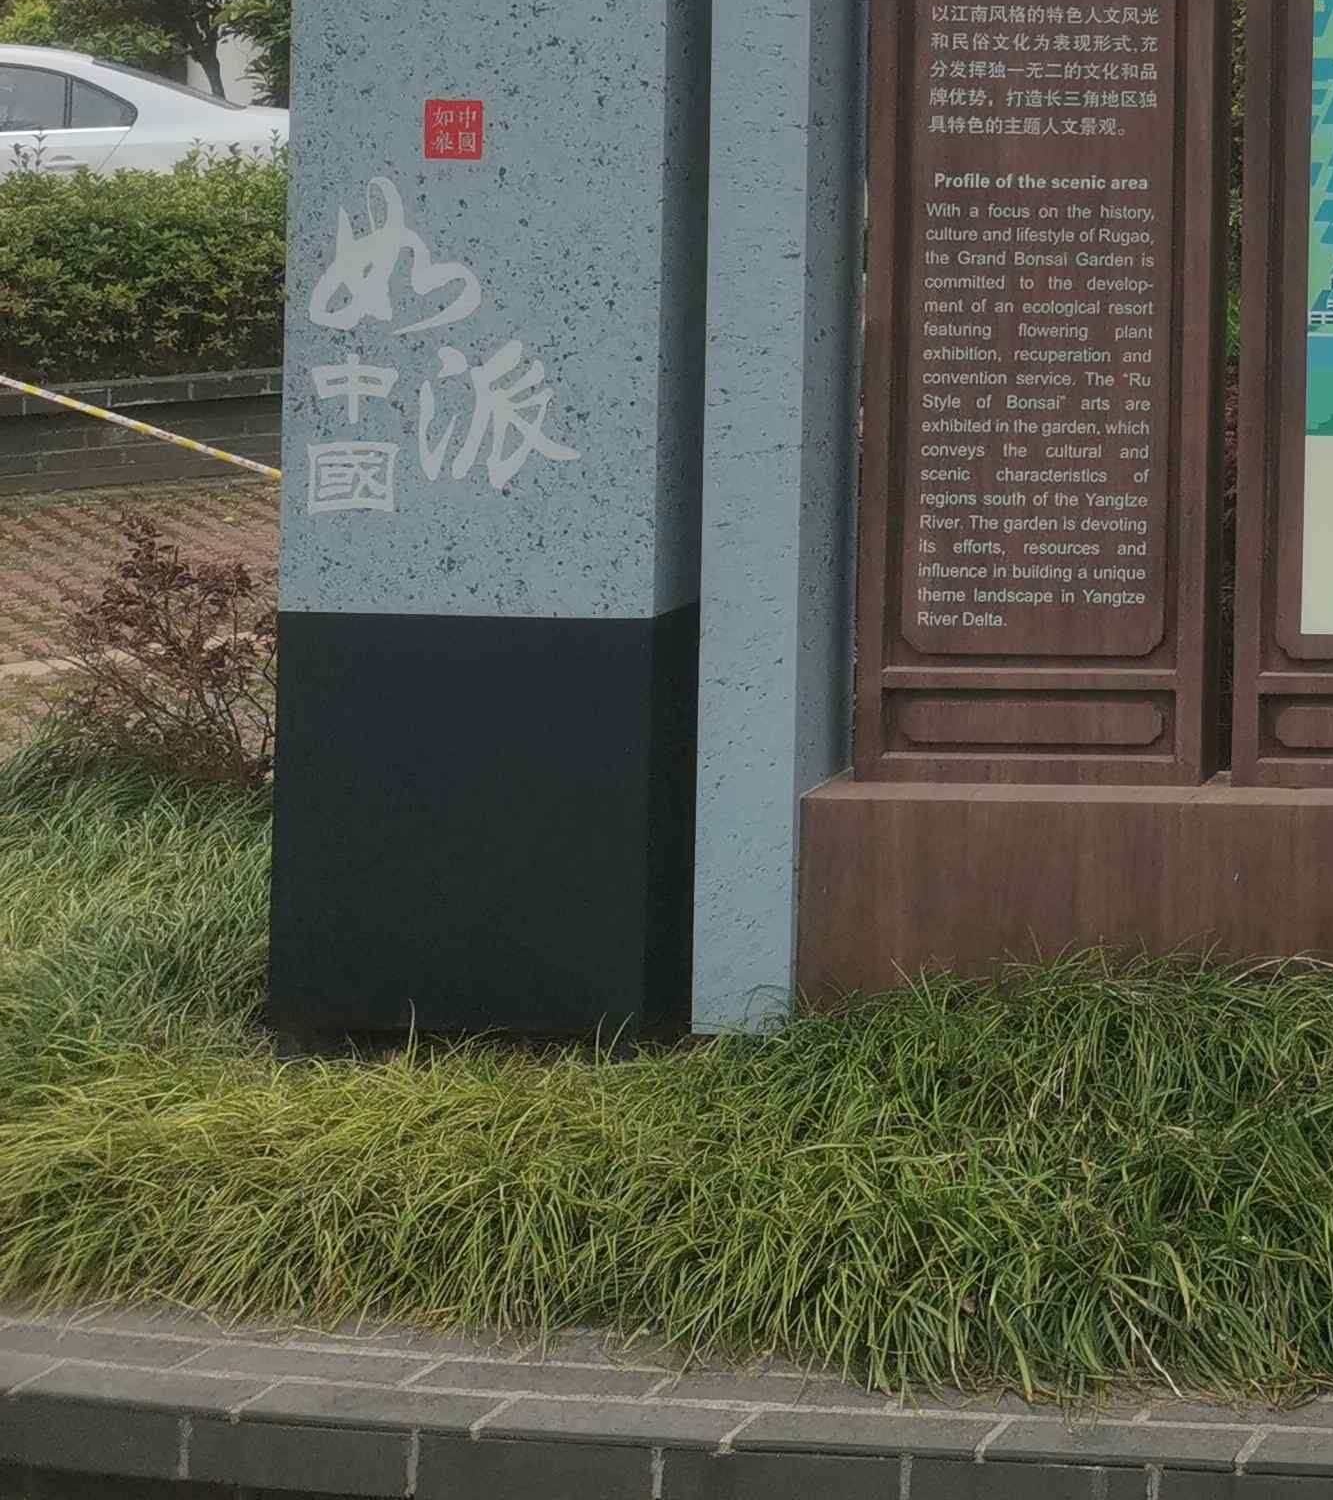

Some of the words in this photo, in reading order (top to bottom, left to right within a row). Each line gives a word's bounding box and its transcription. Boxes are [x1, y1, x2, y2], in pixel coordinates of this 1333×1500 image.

[931, 3, 1161, 27] 以江南风格的特色人文风光
[929, 59, 1158, 83] 分发挥独一无二的文化和品
[934, 169, 991, 189] Profile
[995, 172, 1014, 190] of
[1017, 172, 1050, 190] the
[1050, 174, 1107, 191] scenic
[1110, 177, 1149, 191] area
[925, 201, 961, 222] With
[969, 203, 980, 218] a
[987, 202, 1031, 219] focus
[1037, 203, 1059, 219] on
[1066, 203, 1093, 220] the
[925, 225, 979, 242] culture
[982, 226, 1012, 243] and
[1016, 226, 1075, 246] lifestyle
[1079, 227, 1096, 244] of
[1098, 227, 1155, 247] Rugao,
[924, 248, 950, 266] the
[957, 250, 1007, 266] Grand
[1013, 251, 1068, 268] Bonsai
[1075, 250, 1134, 268] Garden
[1140, 250, 1155, 268] is
[920, 274, 1006, 293] committed
[1019, 275, 1036, 293] to
[1047, 275, 1073, 291] the
[924, 295, 964, 317] ment
[970, 297, 988, 314] of
[994, 300, 1015, 314] an
[1022, 298, 1101, 318] ecological
[1108, 300, 1154, 317] resort
[923, 318, 992, 341] featuring
[1017, 322, 1089, 343] flowering
[1114, 323, 1153, 342] plant
[922, 345, 1002, 364] exhibition,
[1013, 346, 1112, 365] recuperation
[1122, 348, 1152, 363] and
[922, 370, 1008, 385] convention
[1083, 371, 1116, 387] The
[921, 392, 962, 414] Style
[975, 393, 993, 409] of
[1080, 396, 1111, 411] arts
[1124, 398, 1152, 412] are
[919, 417, 992, 434] exhibited
[995, 418, 1012, 433] in
[1013, 418, 1039, 435] the
[1104, 419, 1150, 437] which
[919, 443, 986, 462] conveys
[1002, 441, 1028, 459] the
[1045, 443, 1102, 459] cultural
[1119, 443, 1150, 461] and
[919, 466, 971, 482] scenic
[995, 466, 1108, 485] characteristics
[1133, 467, 1151, 484] of
[919, 488, 977, 510] regions
[983, 491, 1027, 508] south
[1032, 491, 1050, 507] of
[1053, 491, 1079, 507] the
[1085, 491, 1149, 511] Yangtze
[967, 514, 999, 531] The
[1002, 515, 1058, 537] garden
[1061, 515, 1076, 531] is
[1080, 513, 1148, 535] devoting
[918, 536, 937, 559] its
[952, 536, 1006, 557] efforts,
[1023, 542, 1101, 556] resources
[1116, 539, 1147, 557] and
[917, 560, 988, 582] influence
[992, 563, 1007, 578] in
[1012, 563, 1073, 583] building
[1077, 566, 1088, 581] a
[1093, 563, 1147, 583] unique
[917, 585, 966, 609] theme
[973, 587, 1054, 607] landscape
[1060, 588, 1075, 604] in
[1082, 587, 1146, 608] Yangtze
[916, 610, 959, 628] River
[962, 611, 1008, 629] Delta.
